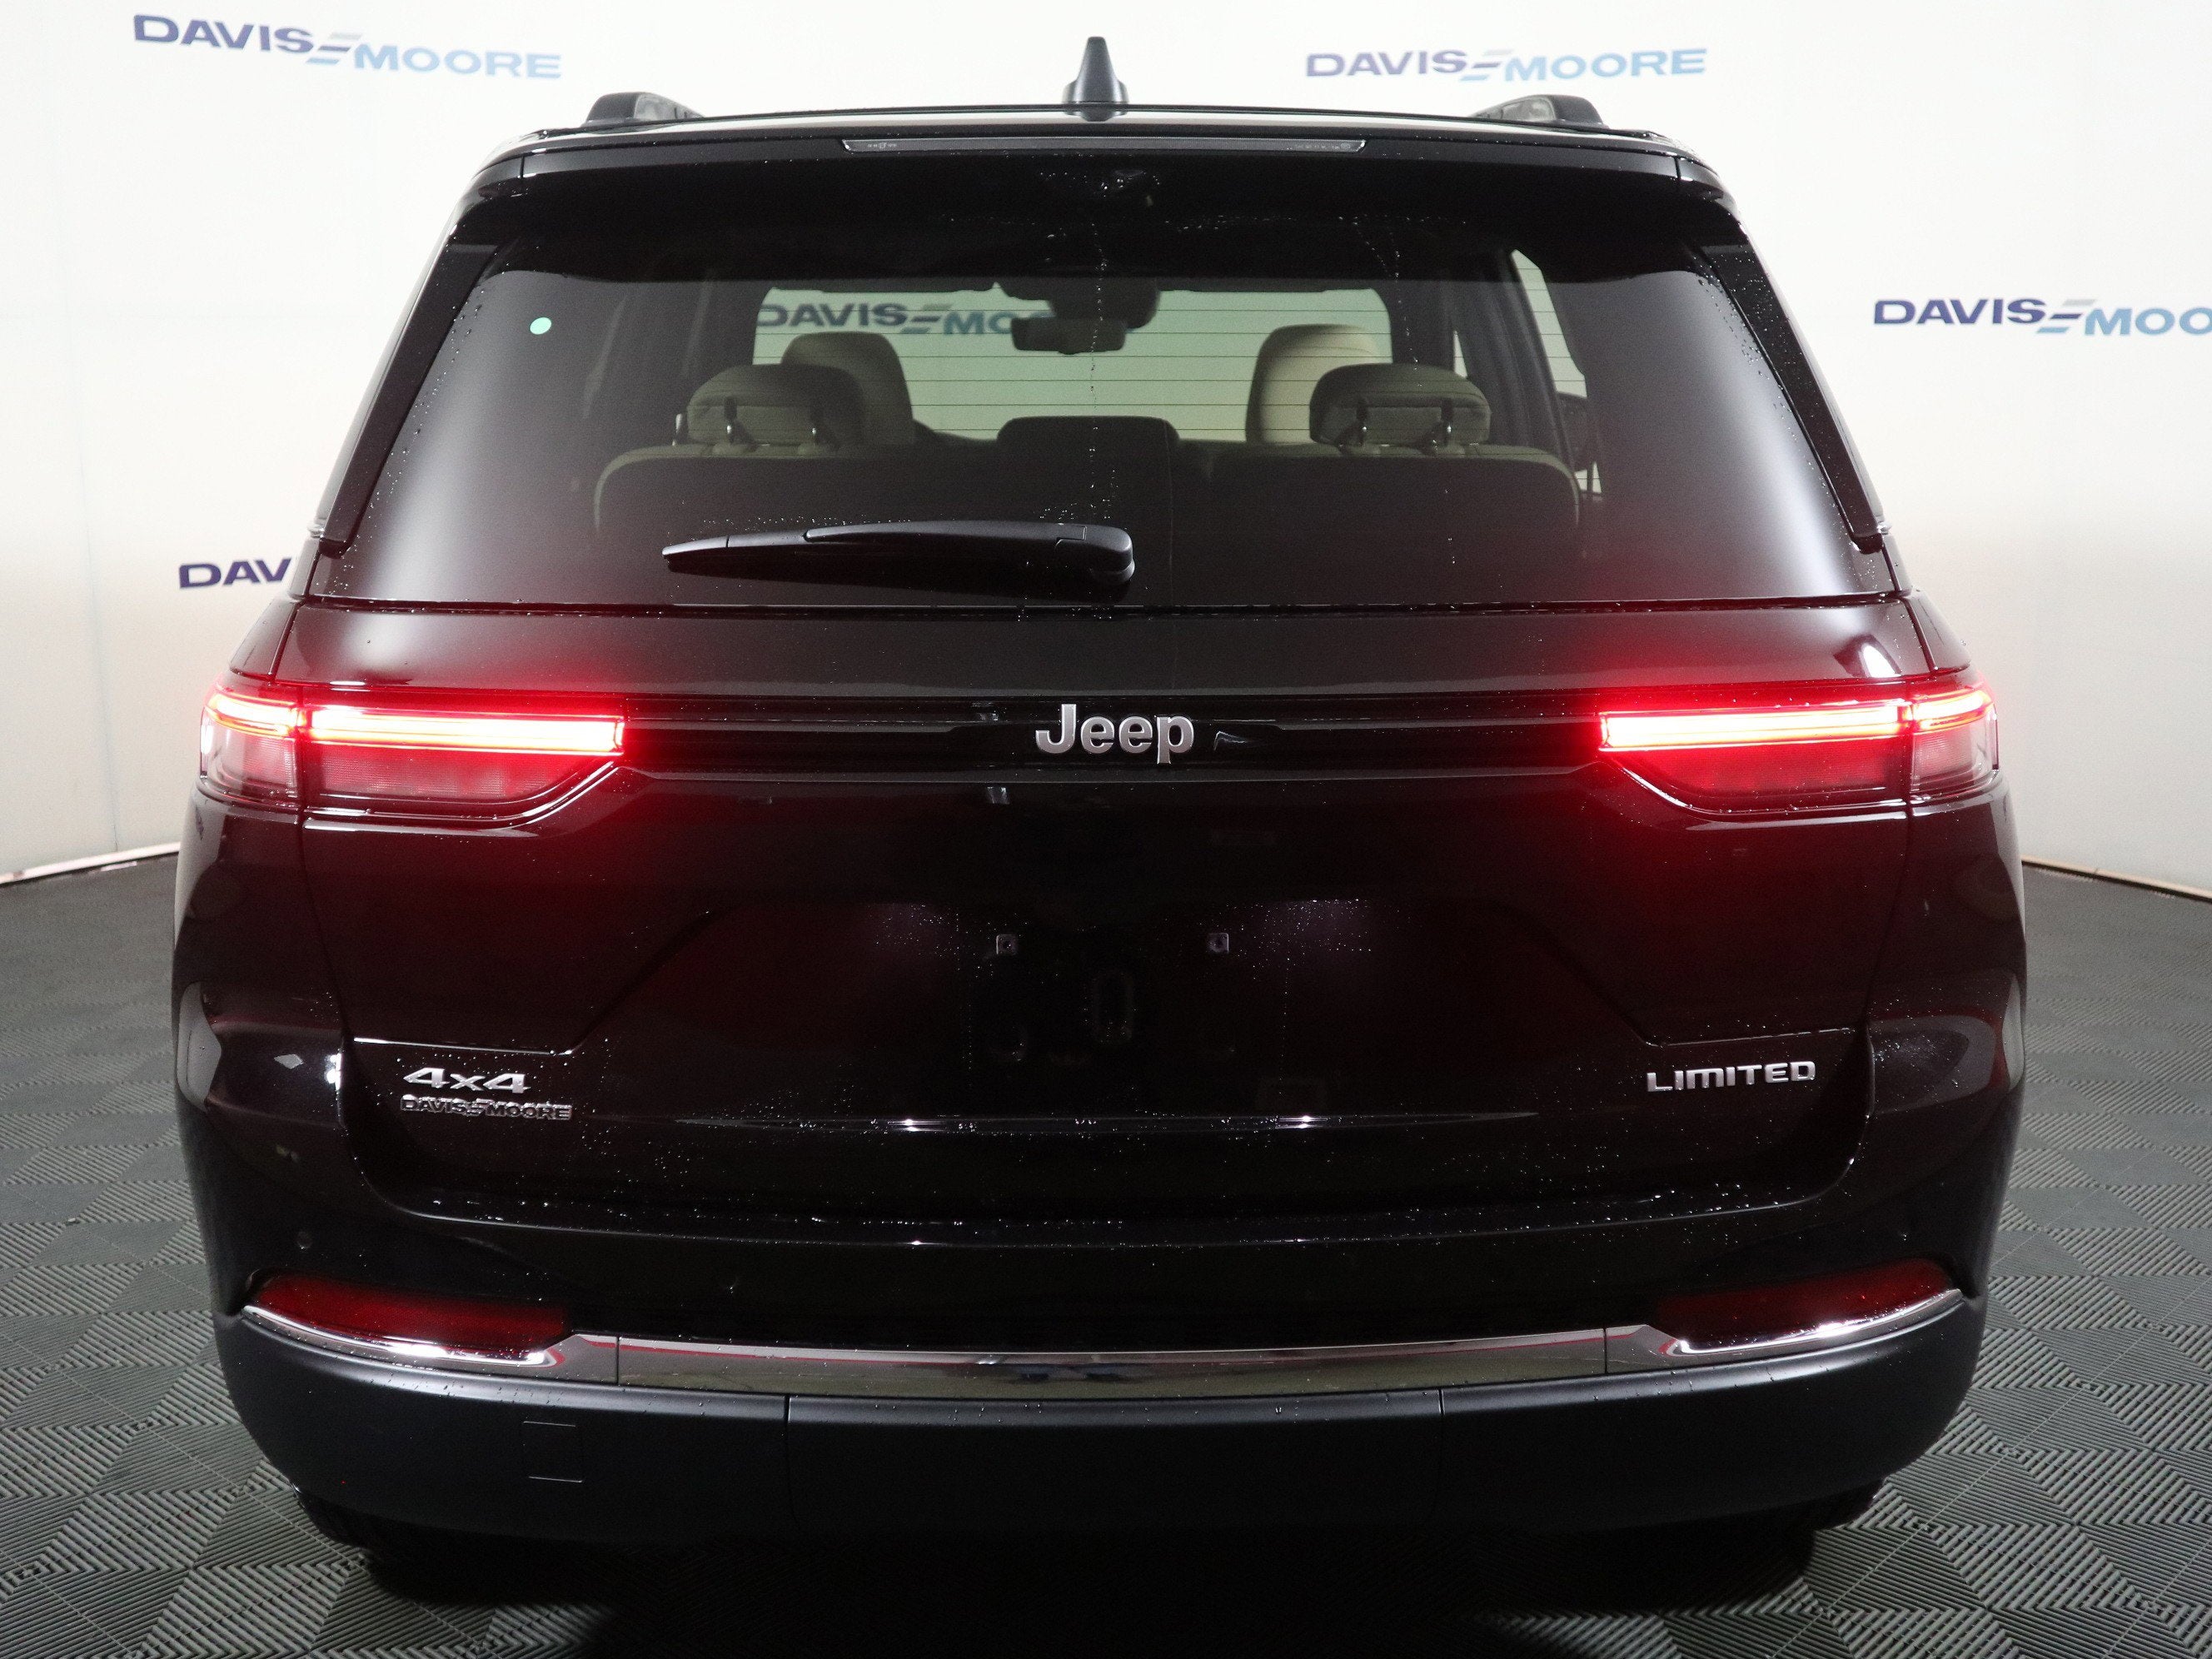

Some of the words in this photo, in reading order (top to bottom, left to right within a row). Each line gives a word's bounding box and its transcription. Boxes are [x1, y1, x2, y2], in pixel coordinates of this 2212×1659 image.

[1035, 704, 1194, 764] Jeep
[403, 1067, 531, 1094] 4x4
[1647, 1061, 1816, 1092] LIMITED
